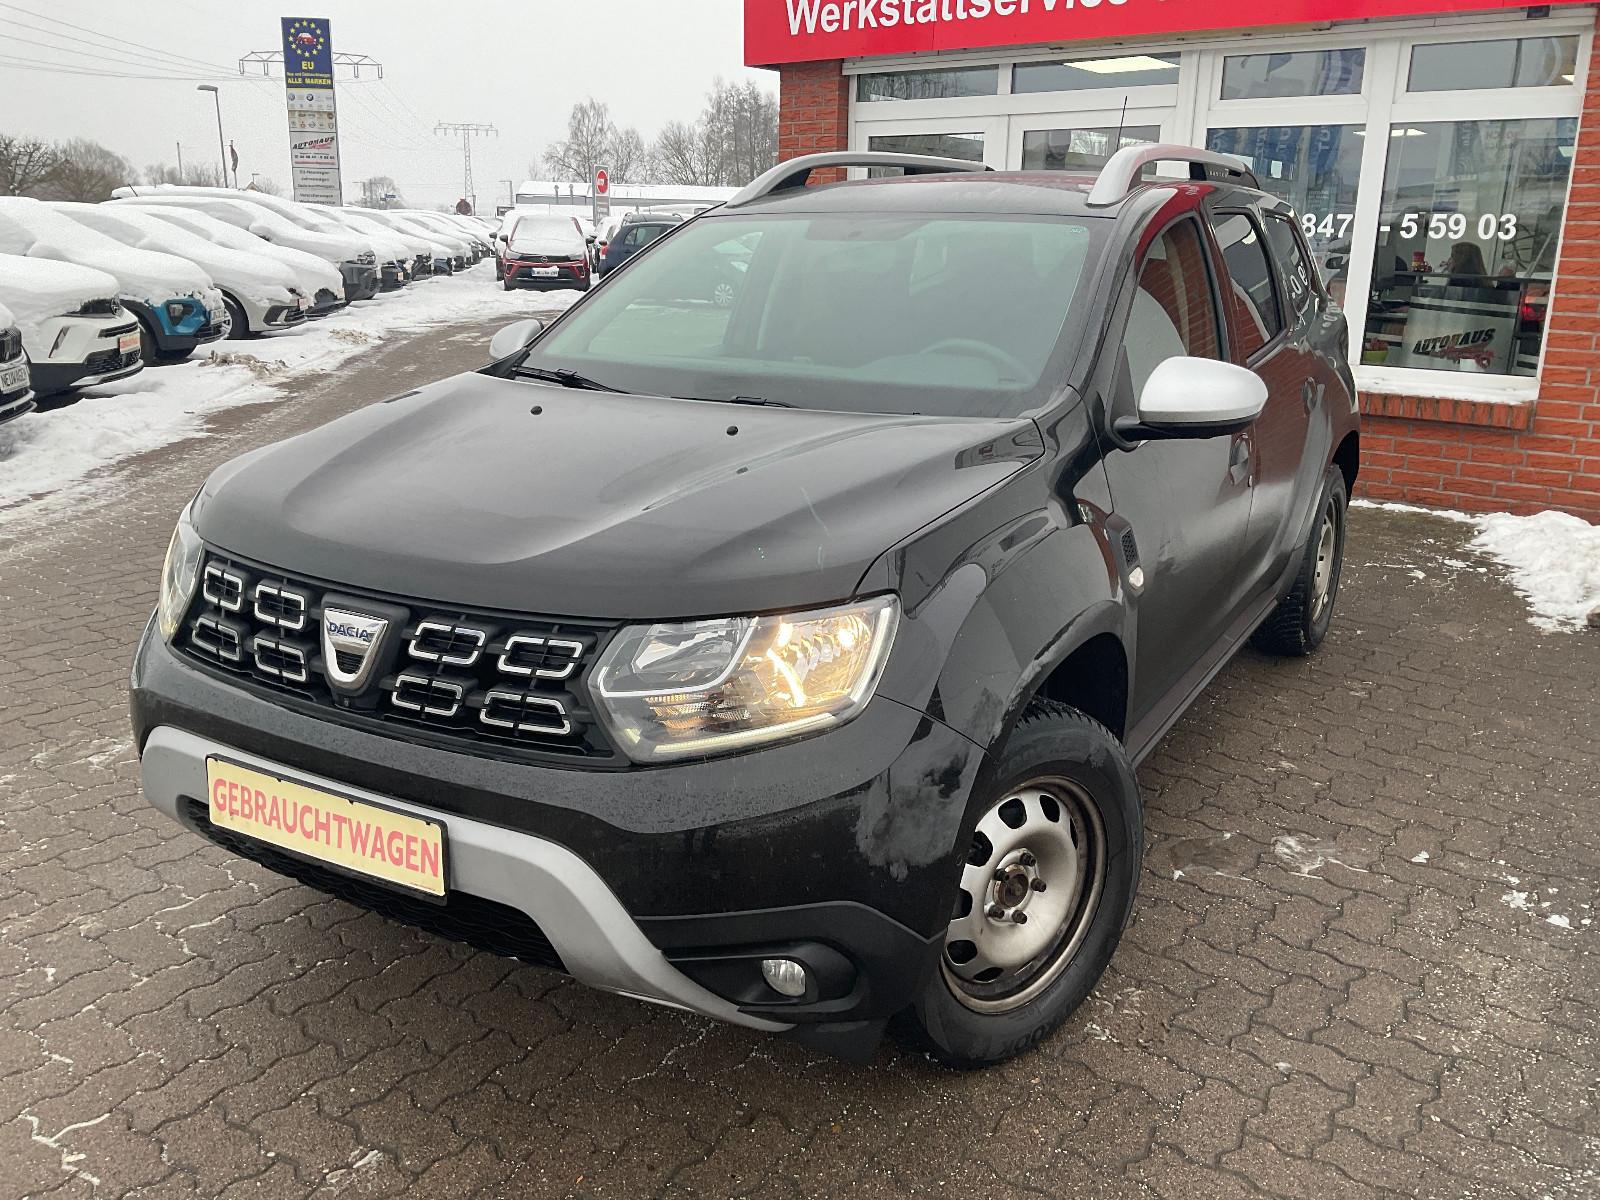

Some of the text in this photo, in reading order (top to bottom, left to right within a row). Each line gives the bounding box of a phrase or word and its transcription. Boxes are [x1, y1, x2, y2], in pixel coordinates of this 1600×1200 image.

[785, 0, 1128, 36] Werkstattse
[301, 60, 314, 70] EU
[292, 136, 335, 150] AUTOHAUS
[1399, 213, 1419, 239] 5
[1428, 213, 1467, 240] 59
[1477, 213, 1517, 240] 03
[1412, 328, 1496, 356] AUTOHAUS
[329, 621, 369, 641] DACIA
[213, 777, 439, 879] GEBRAUCHTWAGEN
